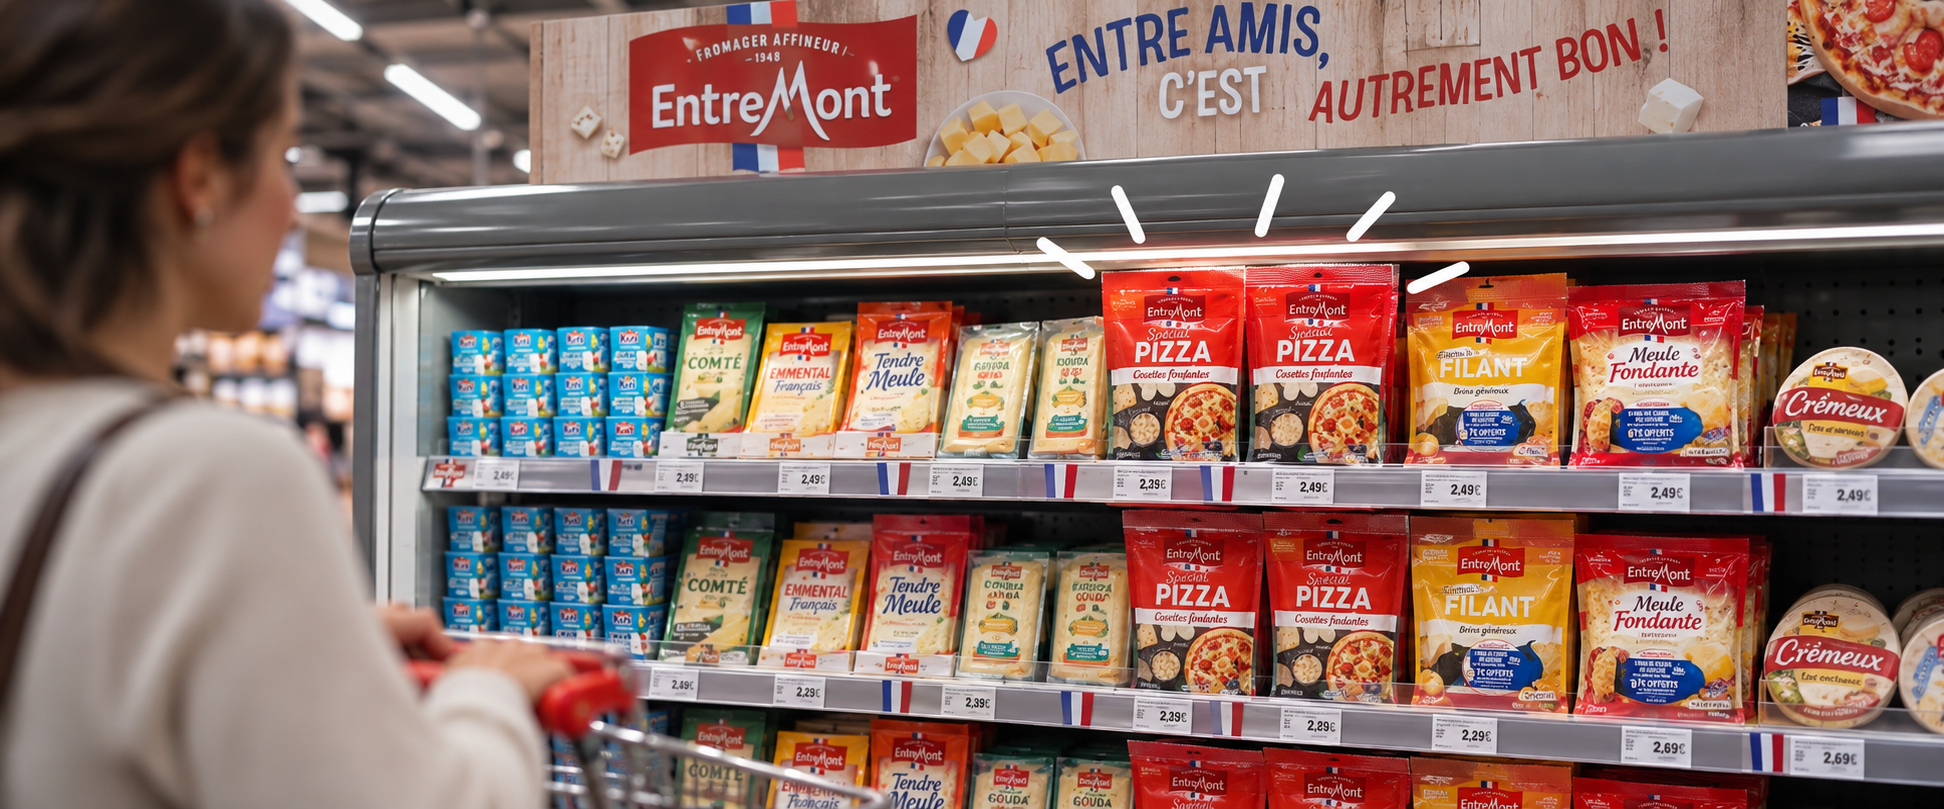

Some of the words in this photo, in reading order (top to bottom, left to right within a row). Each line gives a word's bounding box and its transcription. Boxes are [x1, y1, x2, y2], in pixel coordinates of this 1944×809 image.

[696, 35, 768, 63] FROMAGER
[773, 33, 840, 55] AFFINEUR
[1045, 6, 1191, 94] ENTRE
[1204, 1, 1329, 70] AMIS,
[754, 51, 781, 64] 1948
[1307, 44, 1542, 124] AUTREMENT
[1555, 17, 1642, 81] BON
[1157, 65, 1267, 119] C'EST
[1135, 341, 1212, 363] PIZZA
[1276, 339, 1356, 363] PIZZA
[1628, 346, 1680, 363] Meule
[688, 353, 742, 370] COMTÉ
[874, 352, 925, 369] Tendre
[1440, 356, 1528, 378] FILANT
[770, 367, 831, 379] EMMENTAL
[866, 367, 926, 393] Meule
[1609, 361, 1699, 384] Fondante
[774, 380, 822, 396] Français
[801, 473, 826, 486] 2,49€
[953, 475, 981, 488] 2,49€
[1300, 480, 1328, 494] 2,49€
[1450, 483, 1482, 498] 2,49€
[1650, 486, 1683, 501] 2,49€
[1836, 488, 1872, 503] 2,49€
[687, 577, 748, 596] COMTÉ
[784, 583, 848, 599] EMMENTAL
[890, 576, 941, 594] Tendre
[882, 593, 942, 616] Meule
[1155, 583, 1231, 608] PIZZA
[1296, 586, 1372, 610] PIZZA
[1633, 595, 1684, 613] Meule
[789, 597, 837, 615] Français
[1445, 595, 1535, 618] FILANT
[1613, 610, 1703, 632] Fondante
[965, 697, 990, 710] 2,39€
[1462, 729, 1492, 743] 2,29€
[1653, 741, 1686, 755] 2,69€
[1823, 751, 1858, 766] 2,69€
[892, 773, 942, 792] Tendre
